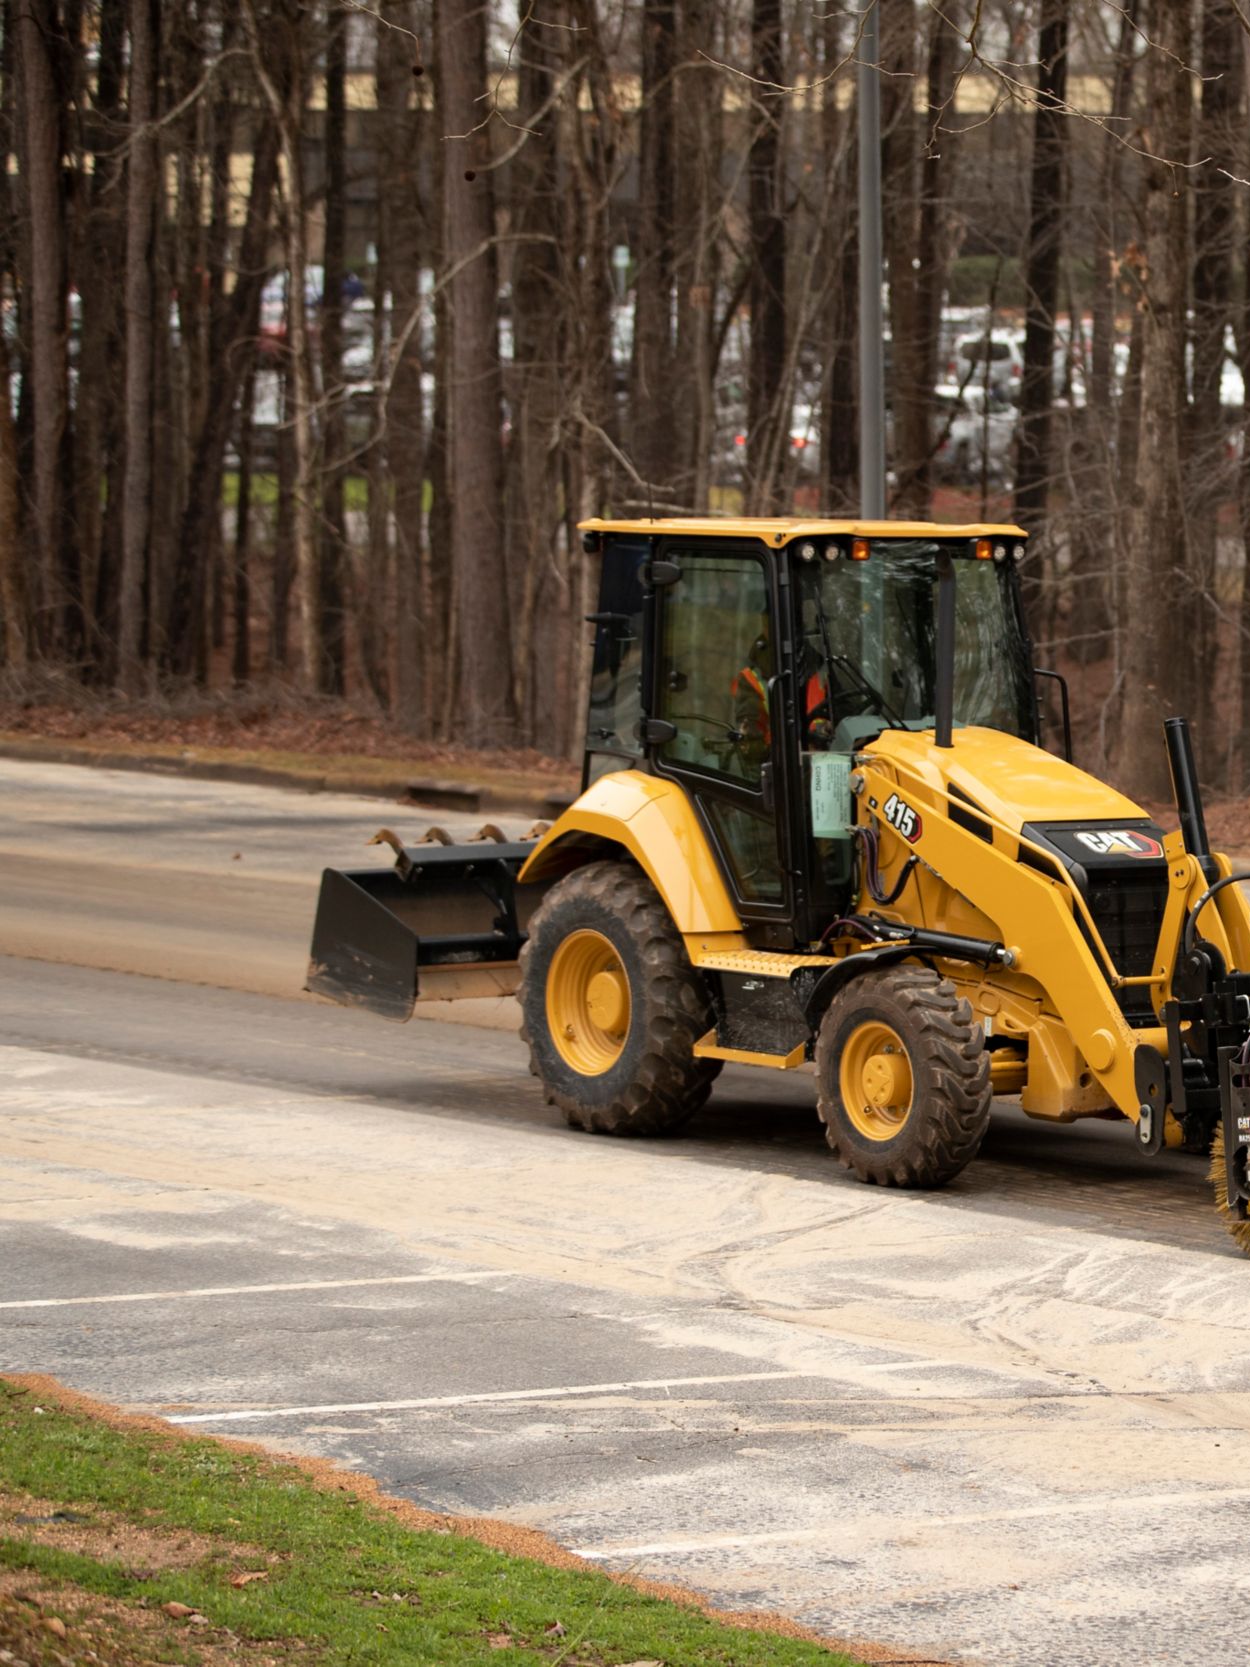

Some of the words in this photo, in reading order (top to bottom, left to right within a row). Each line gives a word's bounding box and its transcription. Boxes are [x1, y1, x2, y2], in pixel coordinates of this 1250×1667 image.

[884, 793, 917, 837] 415
[1075, 831, 1145, 854] CAT
[1237, 1117, 1250, 1130] CAT
